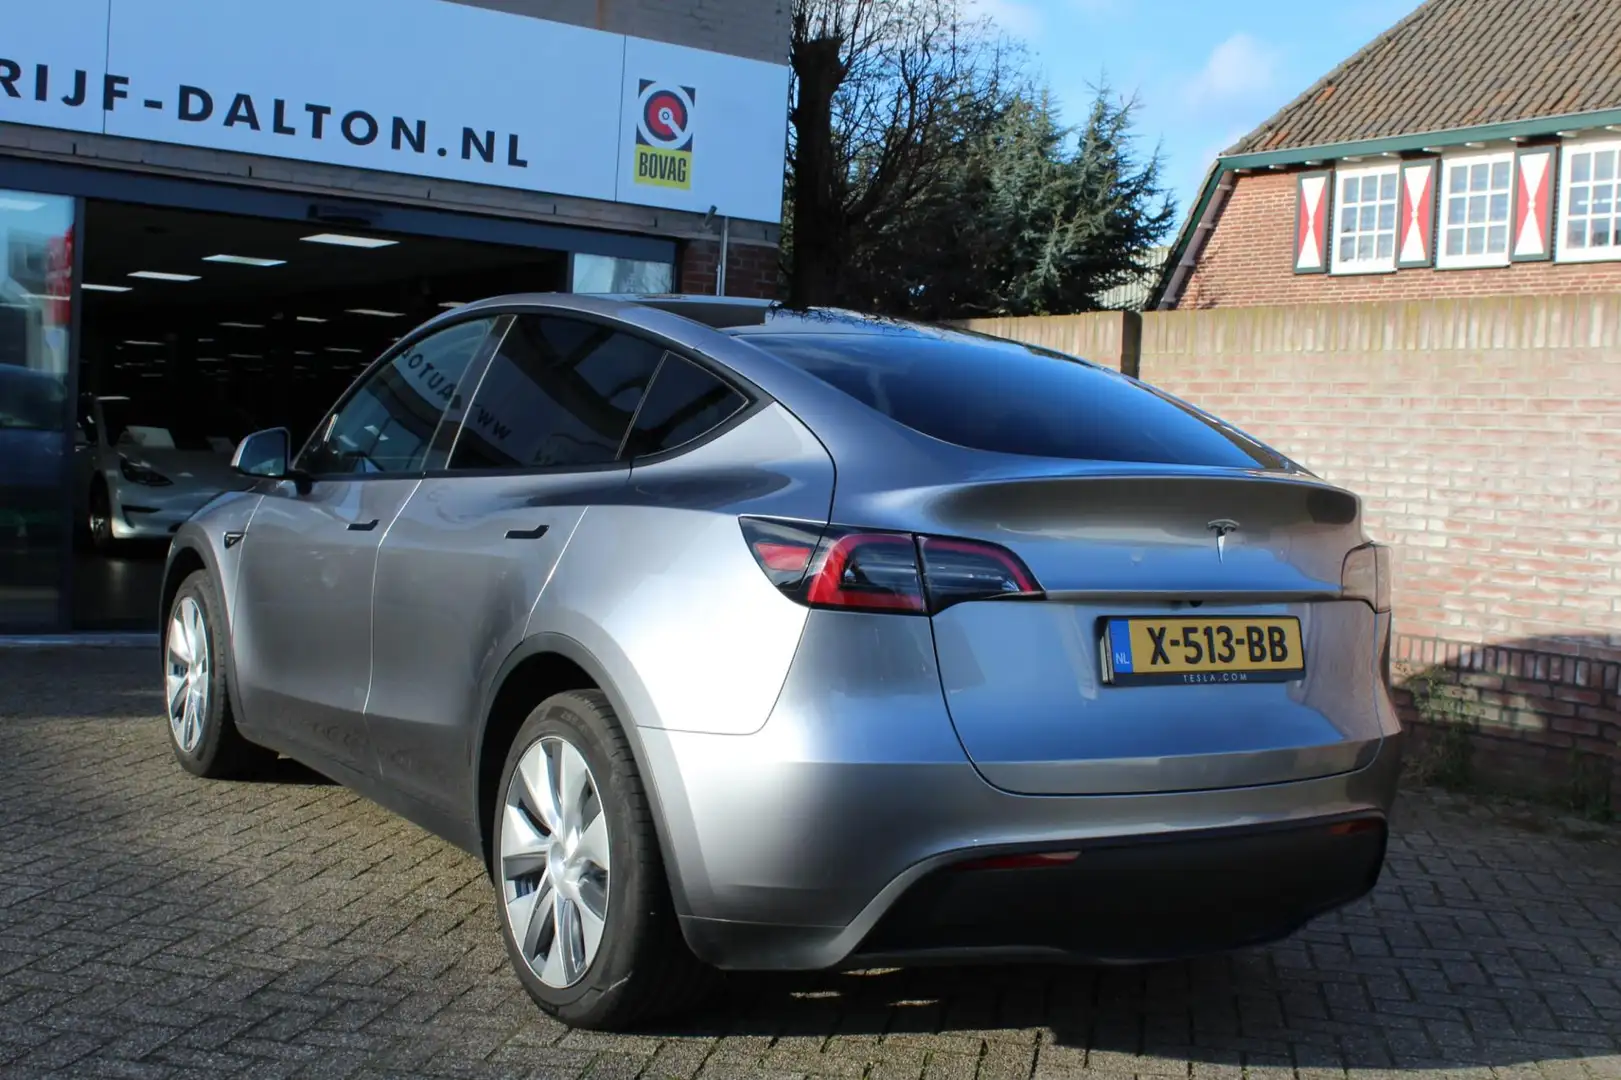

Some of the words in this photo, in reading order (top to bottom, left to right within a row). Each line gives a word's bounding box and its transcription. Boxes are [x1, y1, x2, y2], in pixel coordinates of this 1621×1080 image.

[0, 58, 528, 168] RIJF-DALTON.NL
[638, 151, 687, 183] BOVAG
[1115, 652, 1130, 665] NL
[1147, 625, 1288, 665] X-513-BB
[1183, 673, 1248, 683] TESLA.COM
